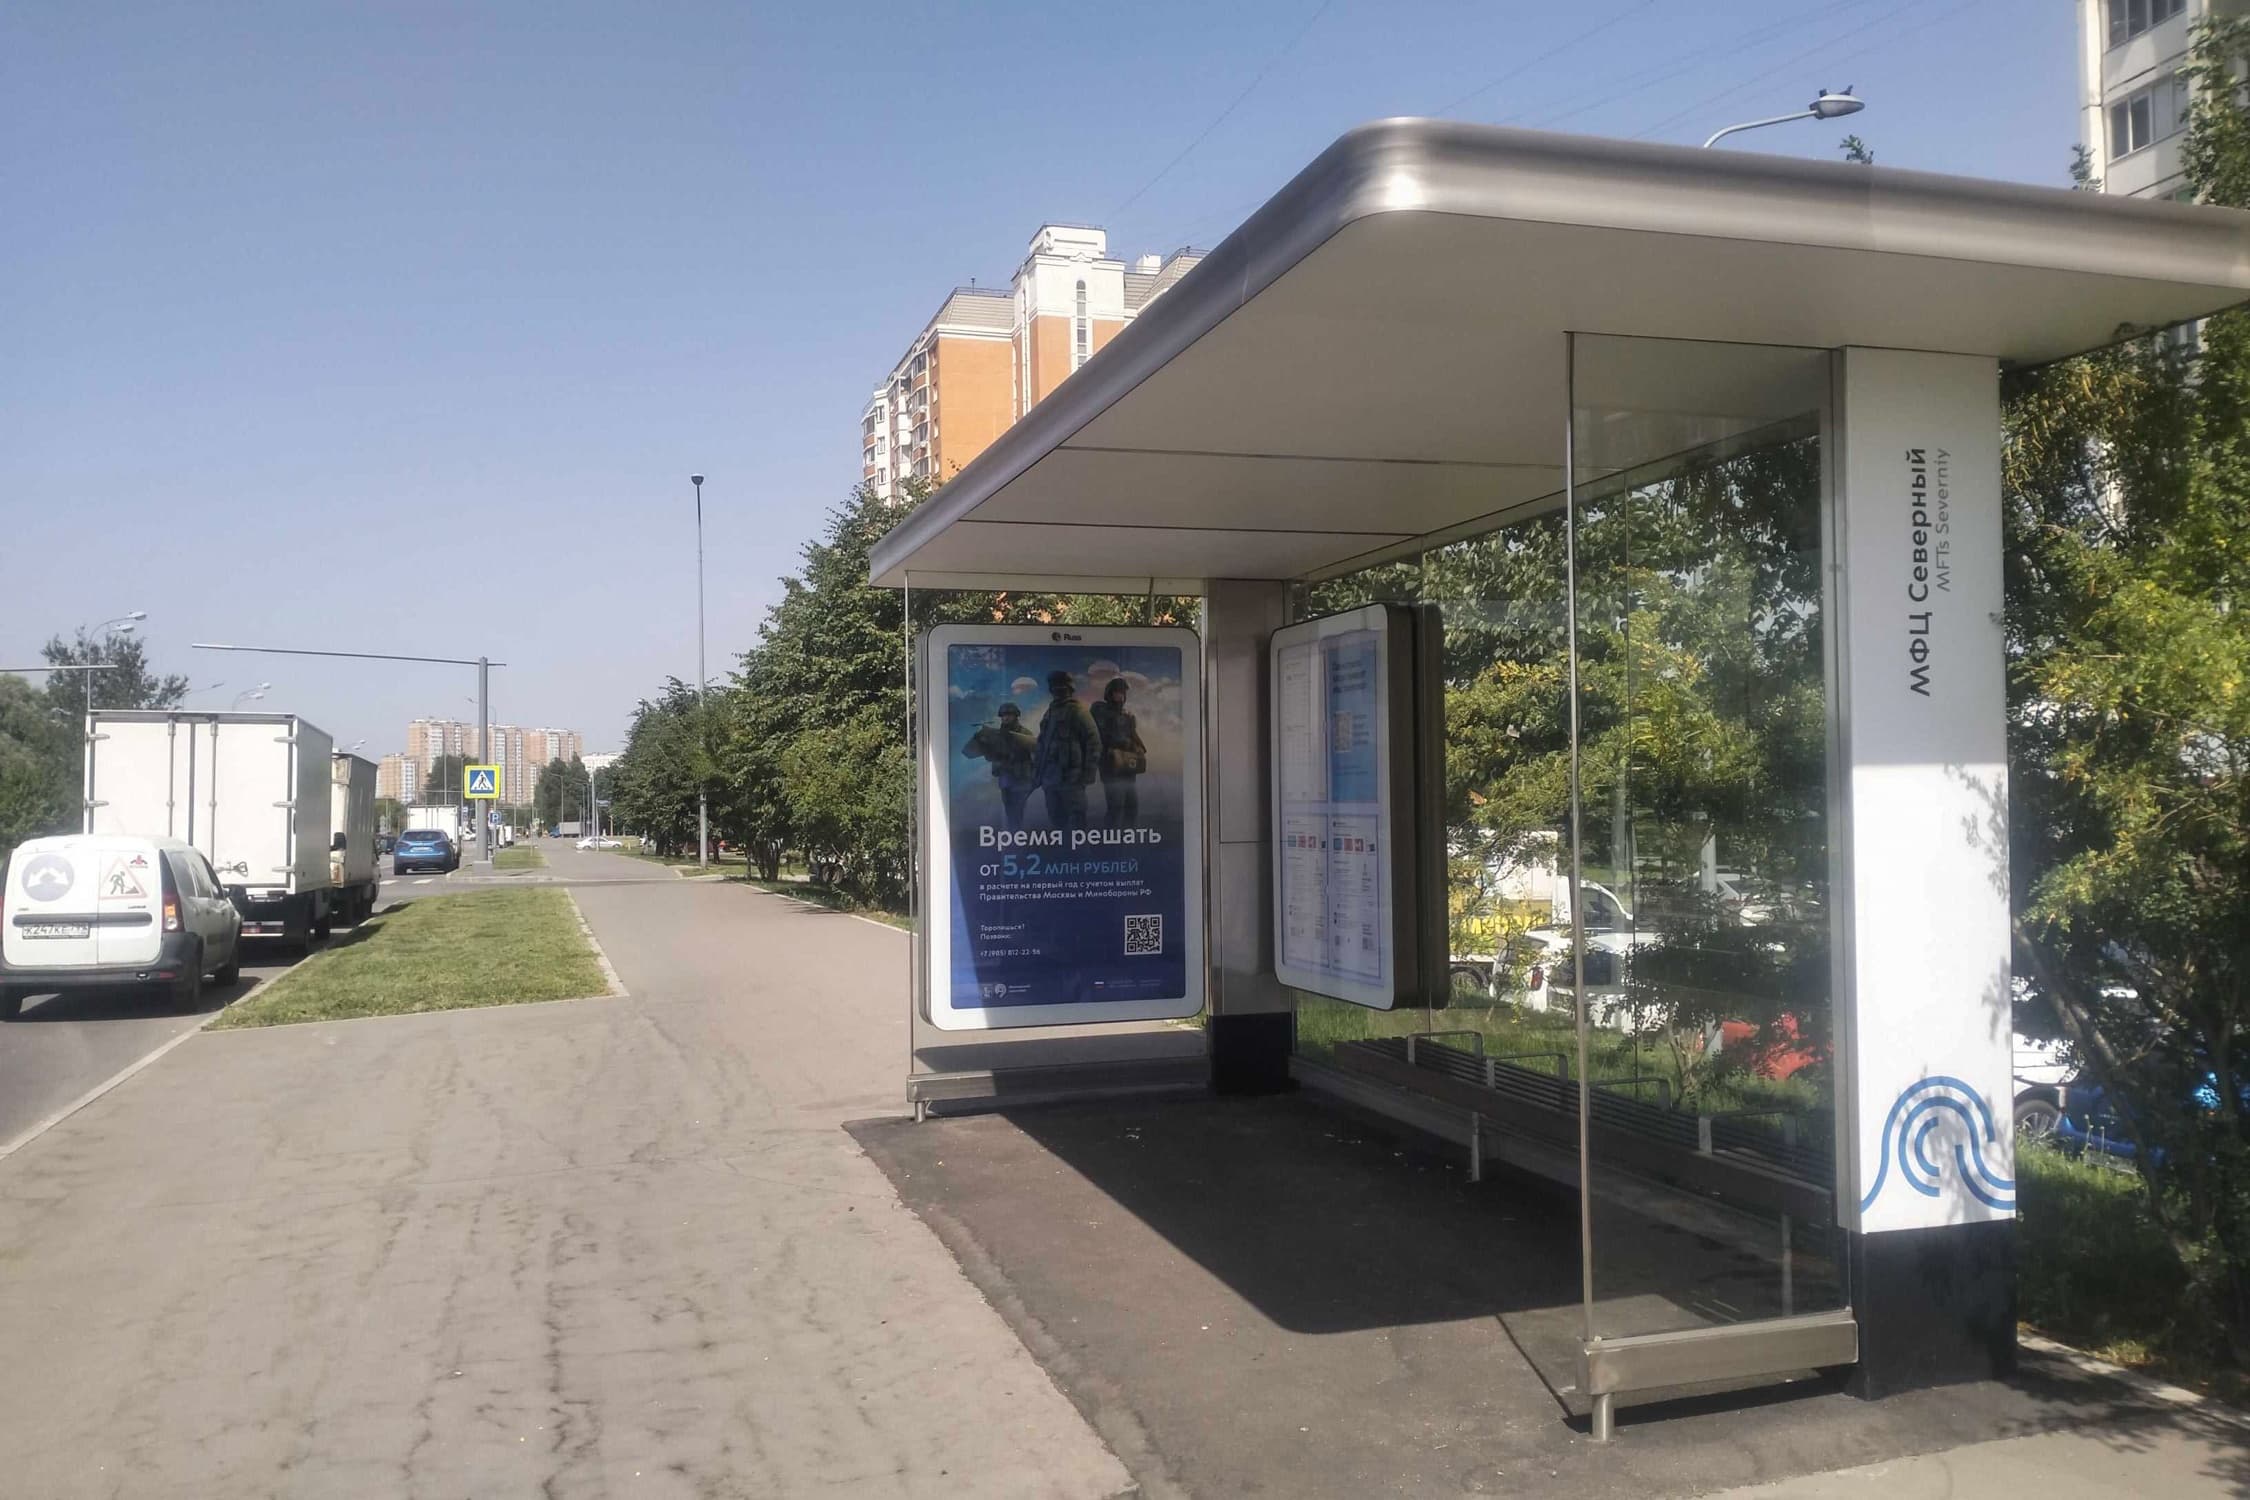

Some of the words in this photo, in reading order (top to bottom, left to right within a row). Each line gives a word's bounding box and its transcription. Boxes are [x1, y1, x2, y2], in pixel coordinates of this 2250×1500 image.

[1934, 448, 1951, 536] Severniy
[1905, 448, 1932, 602] Северный
[1936, 540, 1951, 592] MFTs
[1909, 611, 1933, 697] МФЦ
[979, 825, 1063, 851] Время
[1071, 827, 1162, 850] решать
[986, 883, 1018, 891] расчете
[1032, 881, 1063, 890] первый
[1065, 881, 1078, 889] год
[1086, 881, 1115, 889] учетом
[1003, 854, 1041, 879] 5,2
[1084, 858, 1139, 874] РУБЛЕЙ
[979, 893, 1041, 902] Правительства
[1043, 891, 1076, 899] Москвы
[1085, 889, 1138, 898] Минобороны
[1139, 888, 1152, 896] РФ
